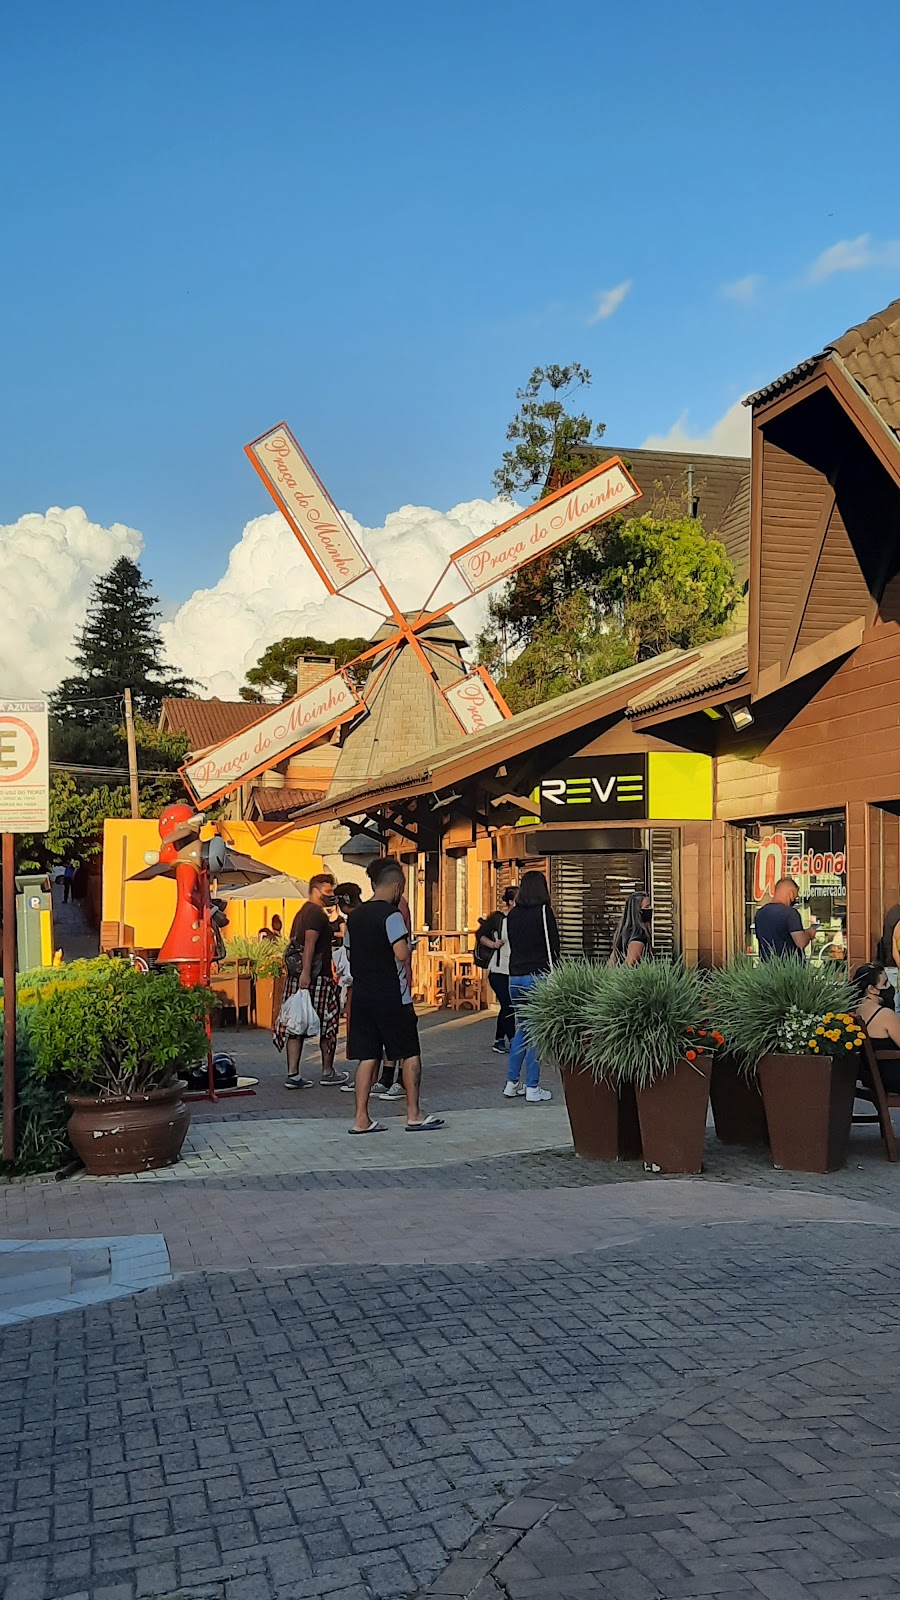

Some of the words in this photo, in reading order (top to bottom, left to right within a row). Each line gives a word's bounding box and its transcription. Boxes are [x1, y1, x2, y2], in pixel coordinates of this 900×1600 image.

[264, 436, 298, 489] Praça
[294, 491, 315, 509] do
[306, 508, 355, 576] Moinho
[467, 541, 526, 579] Praça
[529, 522, 550, 545] do
[550, 479, 626, 530] Moinho
[7, 703, 33, 711] AZUL
[456, 683, 487, 733] Praç
[0, 730, 17, 768] E
[193, 752, 251, 789] Praça
[253, 732, 272, 755] do
[273, 687, 347, 740] Moinho
[541, 775, 643, 805] REVE
